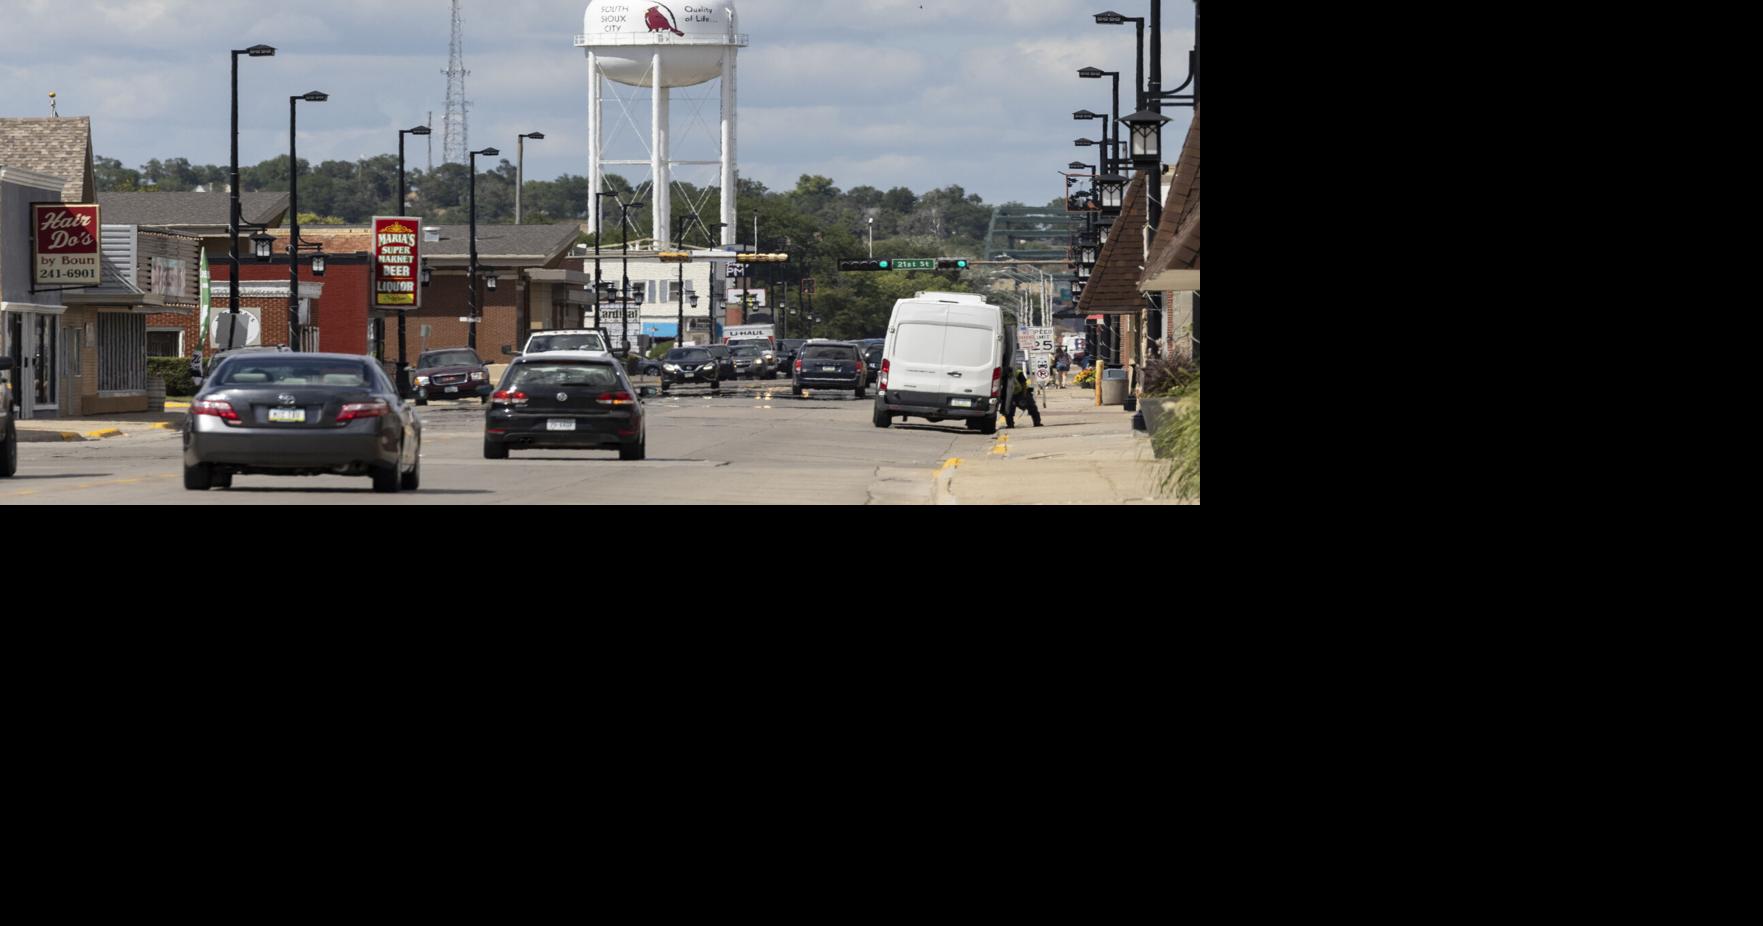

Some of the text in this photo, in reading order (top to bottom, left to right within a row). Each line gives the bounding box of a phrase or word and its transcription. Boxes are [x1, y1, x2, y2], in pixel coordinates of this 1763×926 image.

[600, 5, 629, 13] SOUTH
[684, 5, 713, 14] Quality
[600, 15, 627, 23] SIOUX
[604, 24, 622, 33] CITY
[41, 211, 92, 231] Hair
[48, 230, 94, 250] Do's
[377, 233, 416, 247] MARIA'S
[381, 246, 411, 255] SUPER
[41, 256, 95, 267] by Boun
[378, 255, 415, 263] MARKET
[40, 269, 95, 279] 241-6901
[383, 265, 410, 277] BEER
[377, 281, 414, 292] LIQUOR
[1031, 340, 1053, 350] 25
